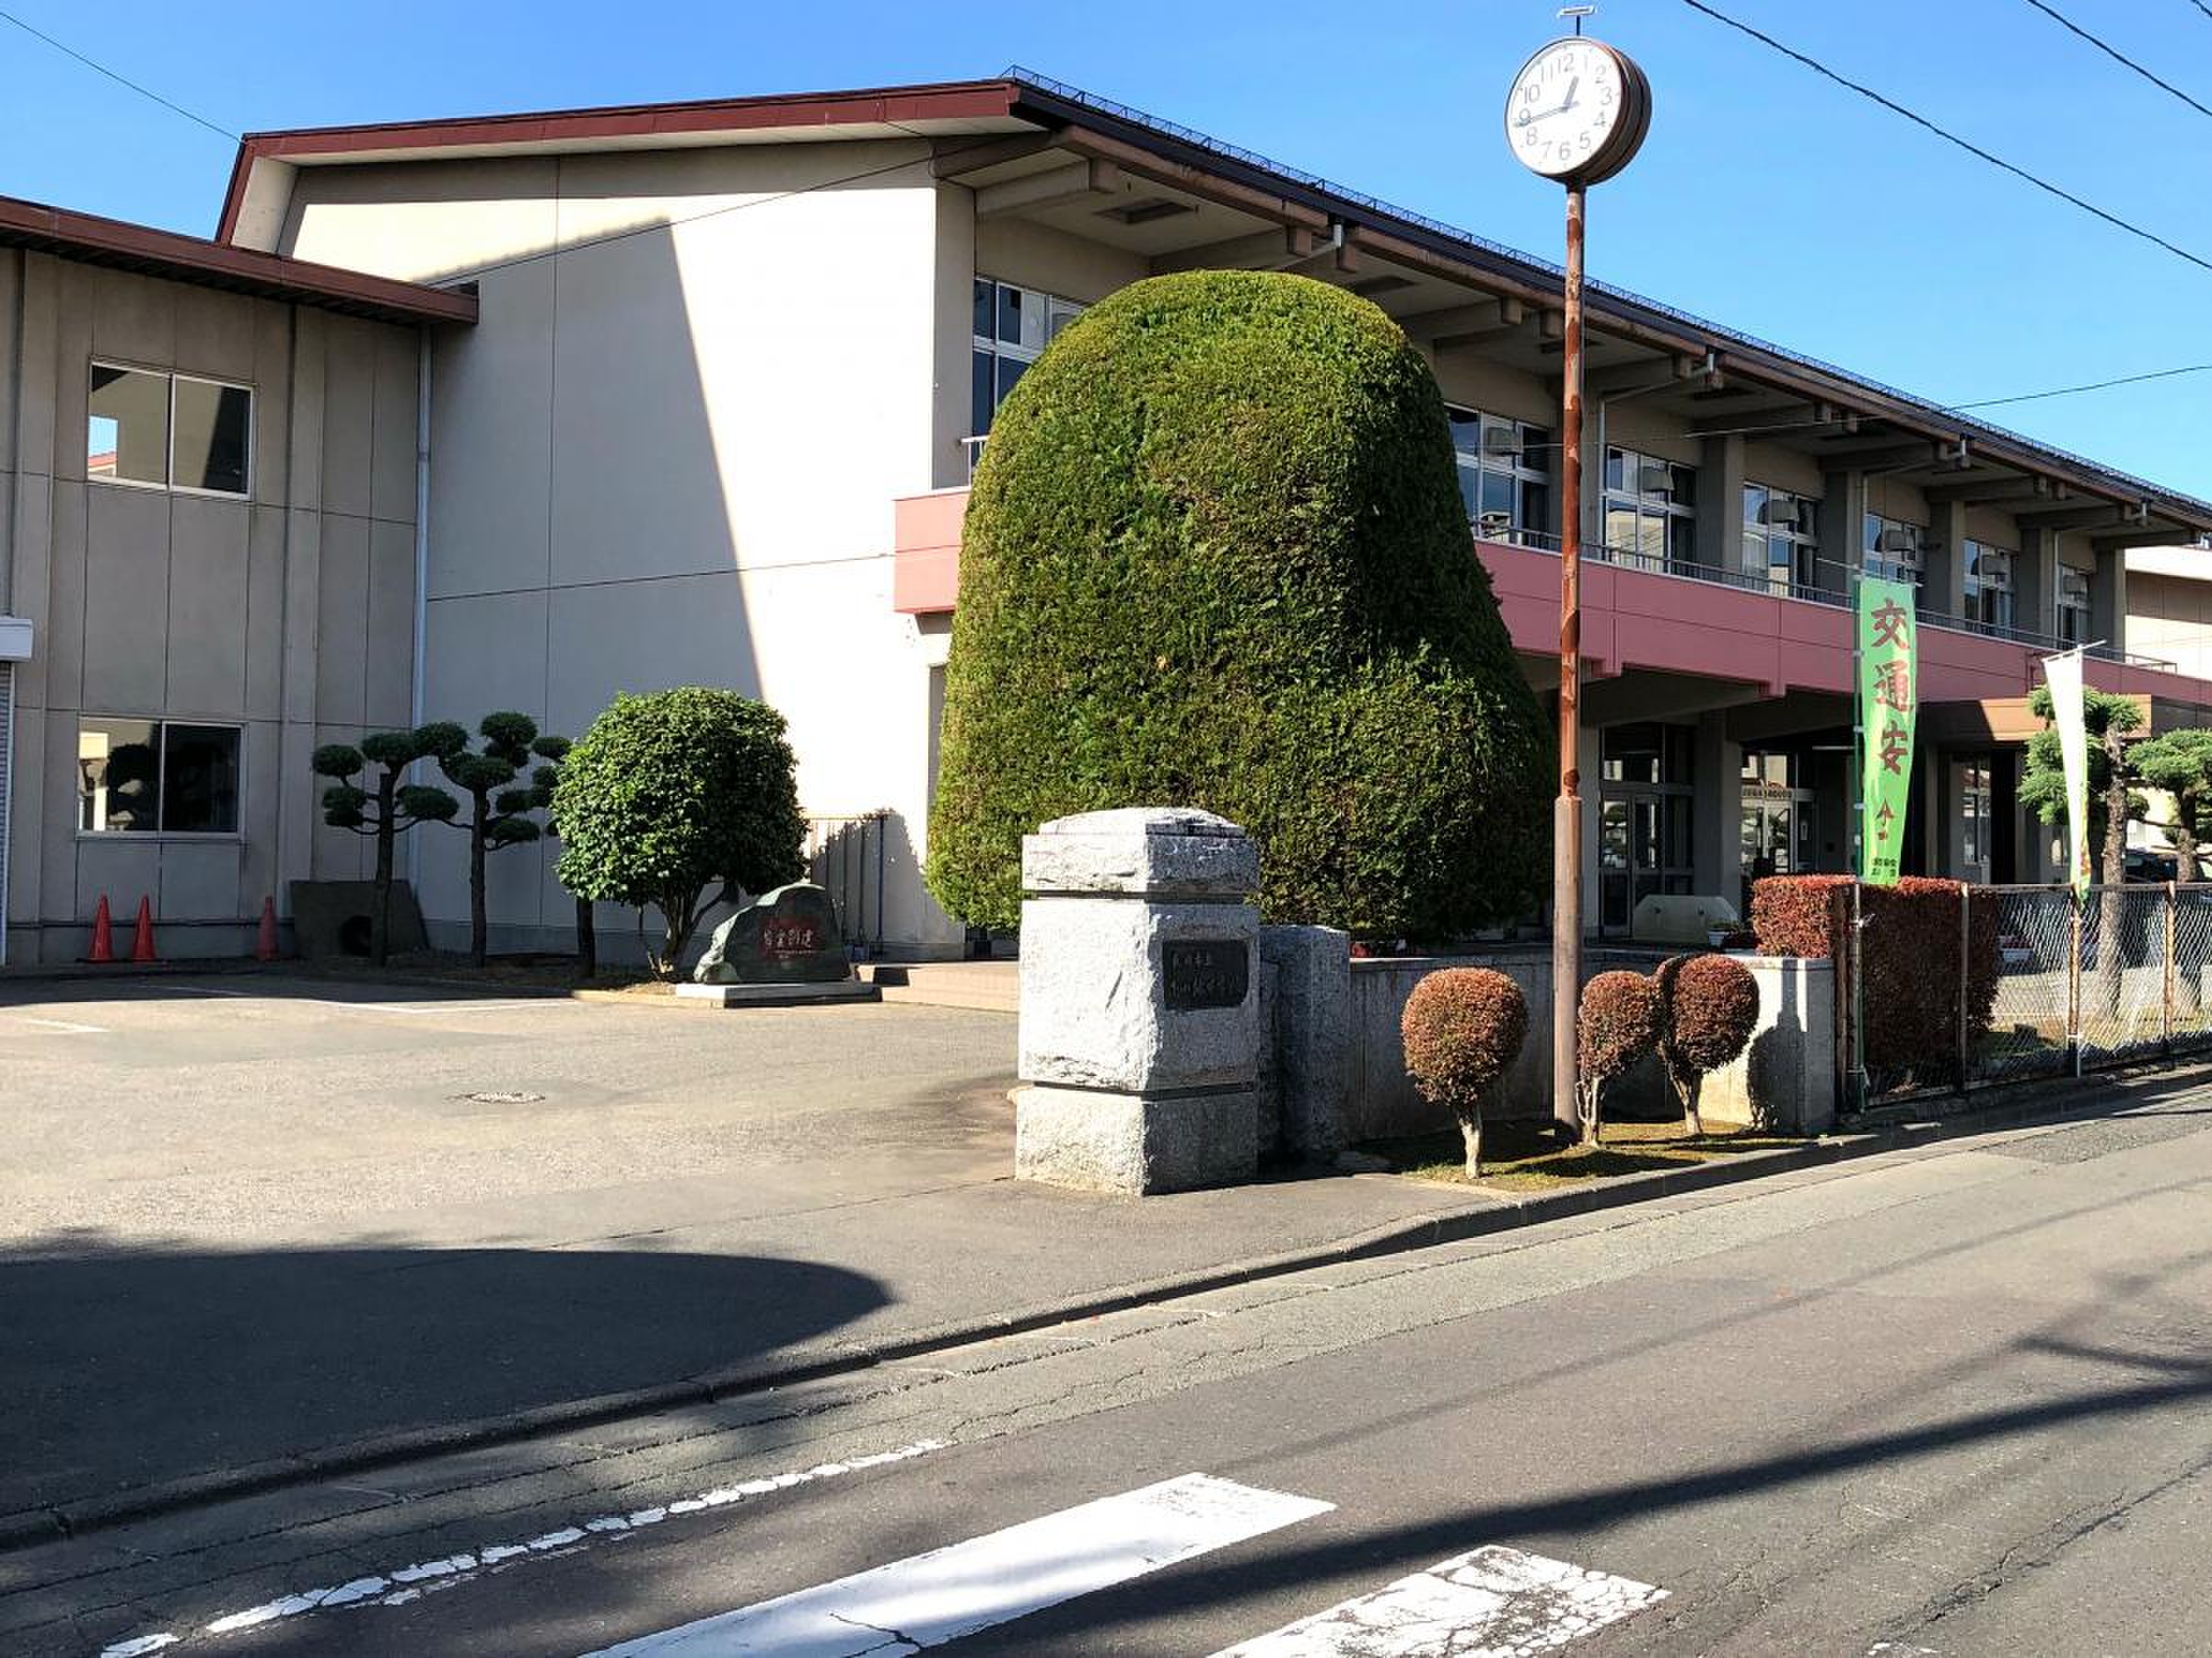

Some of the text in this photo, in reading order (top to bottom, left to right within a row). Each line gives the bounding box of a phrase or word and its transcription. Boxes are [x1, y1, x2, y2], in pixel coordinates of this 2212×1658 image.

[1557, 52, 1576, 74] 12
[1540, 64, 1554, 83] 11
[1594, 64, 1607, 84] 2
[1523, 84, 1541, 104] 10
[1600, 87, 1612, 106] 3
[1519, 107, 1532, 127] 9
[1592, 110, 1607, 128] 4
[1526, 126, 1539, 146] 8
[1579, 130, 1591, 149] 5
[1540, 139, 1554, 158] 7
[1558, 141, 1571, 160] 6
